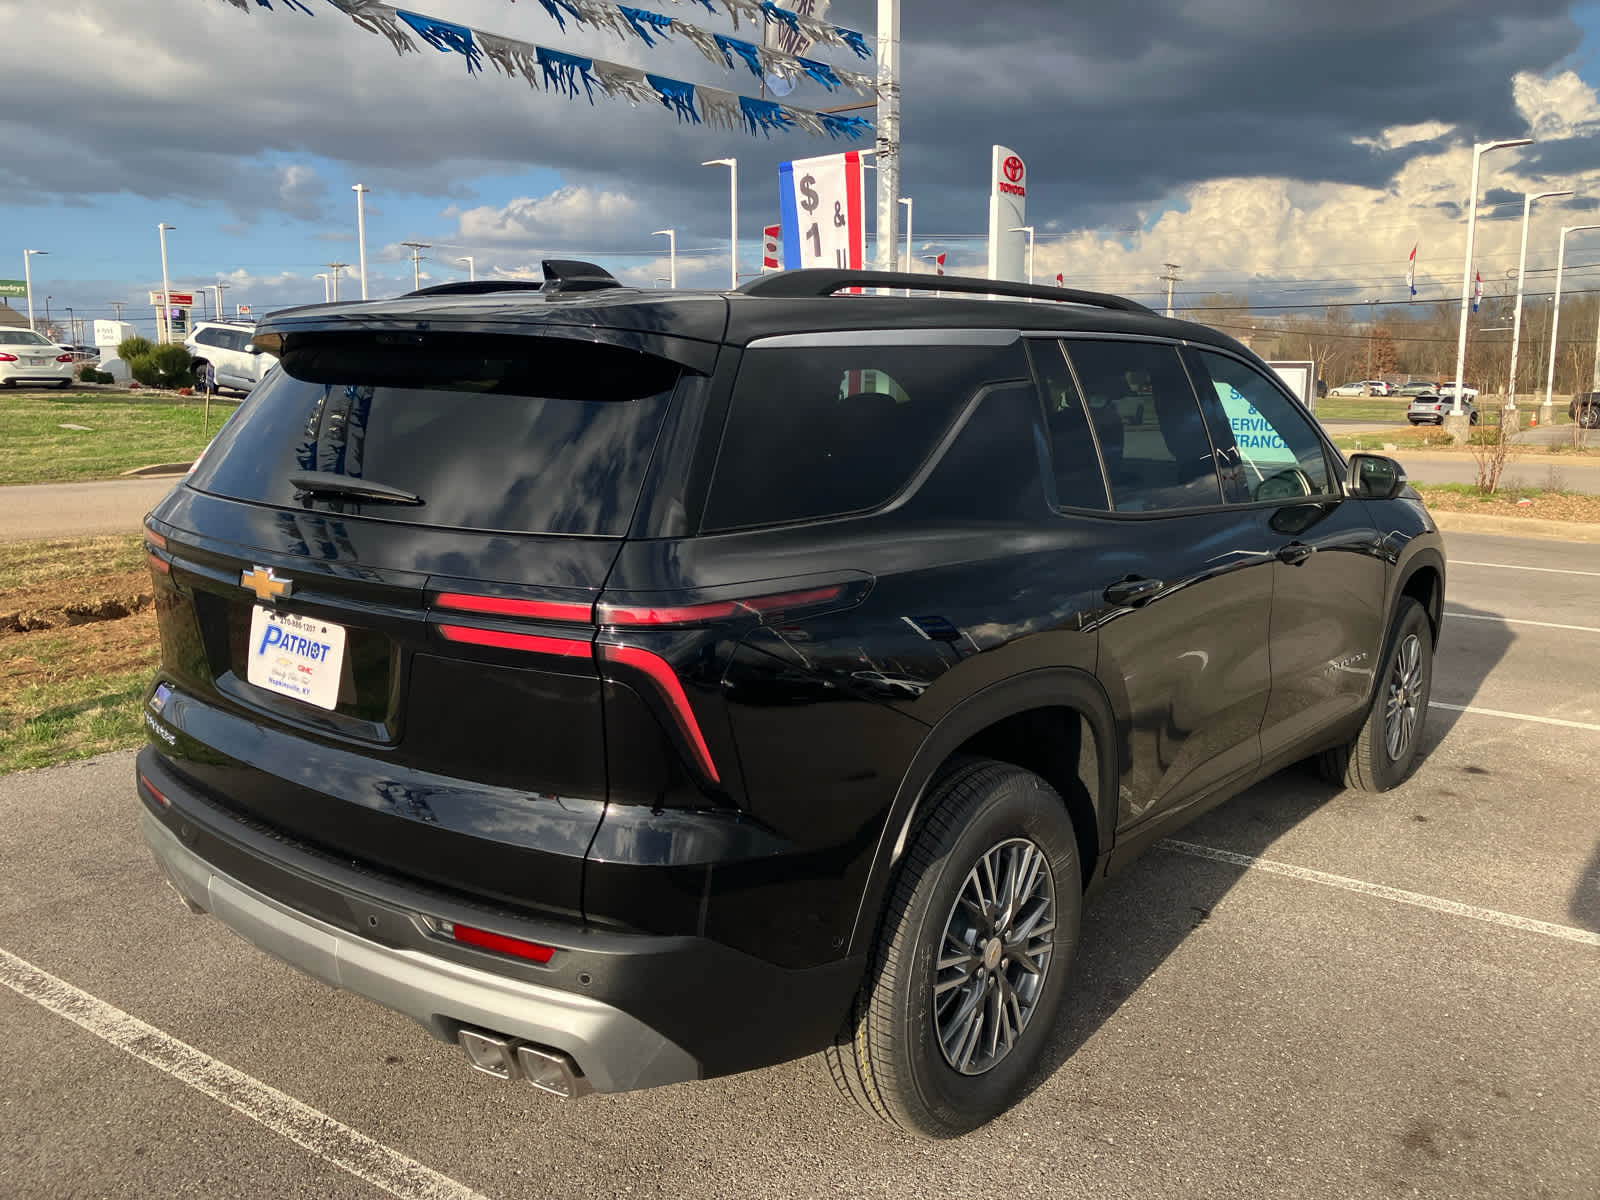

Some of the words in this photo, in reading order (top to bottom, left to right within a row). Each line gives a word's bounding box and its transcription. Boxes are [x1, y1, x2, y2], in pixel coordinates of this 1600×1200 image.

[998, 181, 1025, 197] TOYOTA
[1231, 418, 1275, 432] ERVIC
[258, 623, 331, 663] PATRIOT
[297, 664, 313, 676] GMC
